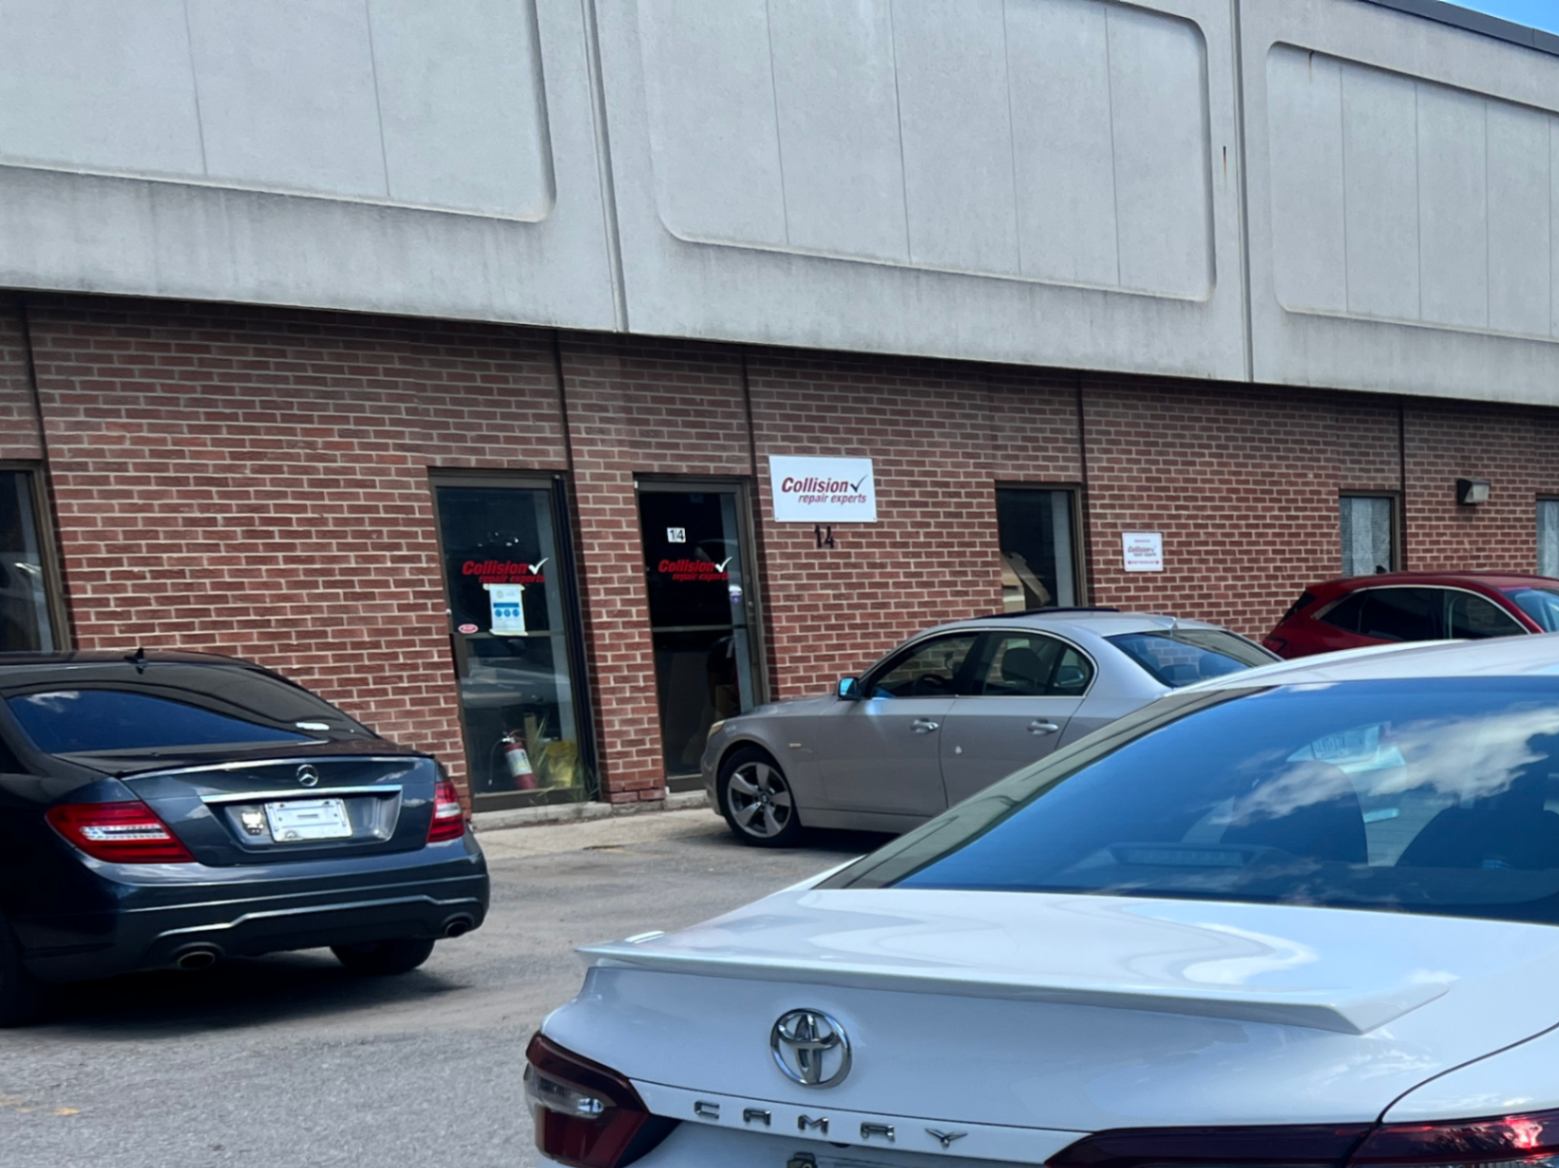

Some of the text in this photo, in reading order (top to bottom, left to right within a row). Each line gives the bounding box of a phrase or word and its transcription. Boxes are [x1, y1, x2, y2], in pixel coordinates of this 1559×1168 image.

[781, 477, 849, 493] Collision
[799, 494, 867, 506] repair experts
[670, 529, 685, 541] 14
[814, 525, 835, 549] 14
[462, 560, 528, 575] Collision
[657, 559, 715, 572] Collision
[694, 1100, 969, 1149] CAMRY
